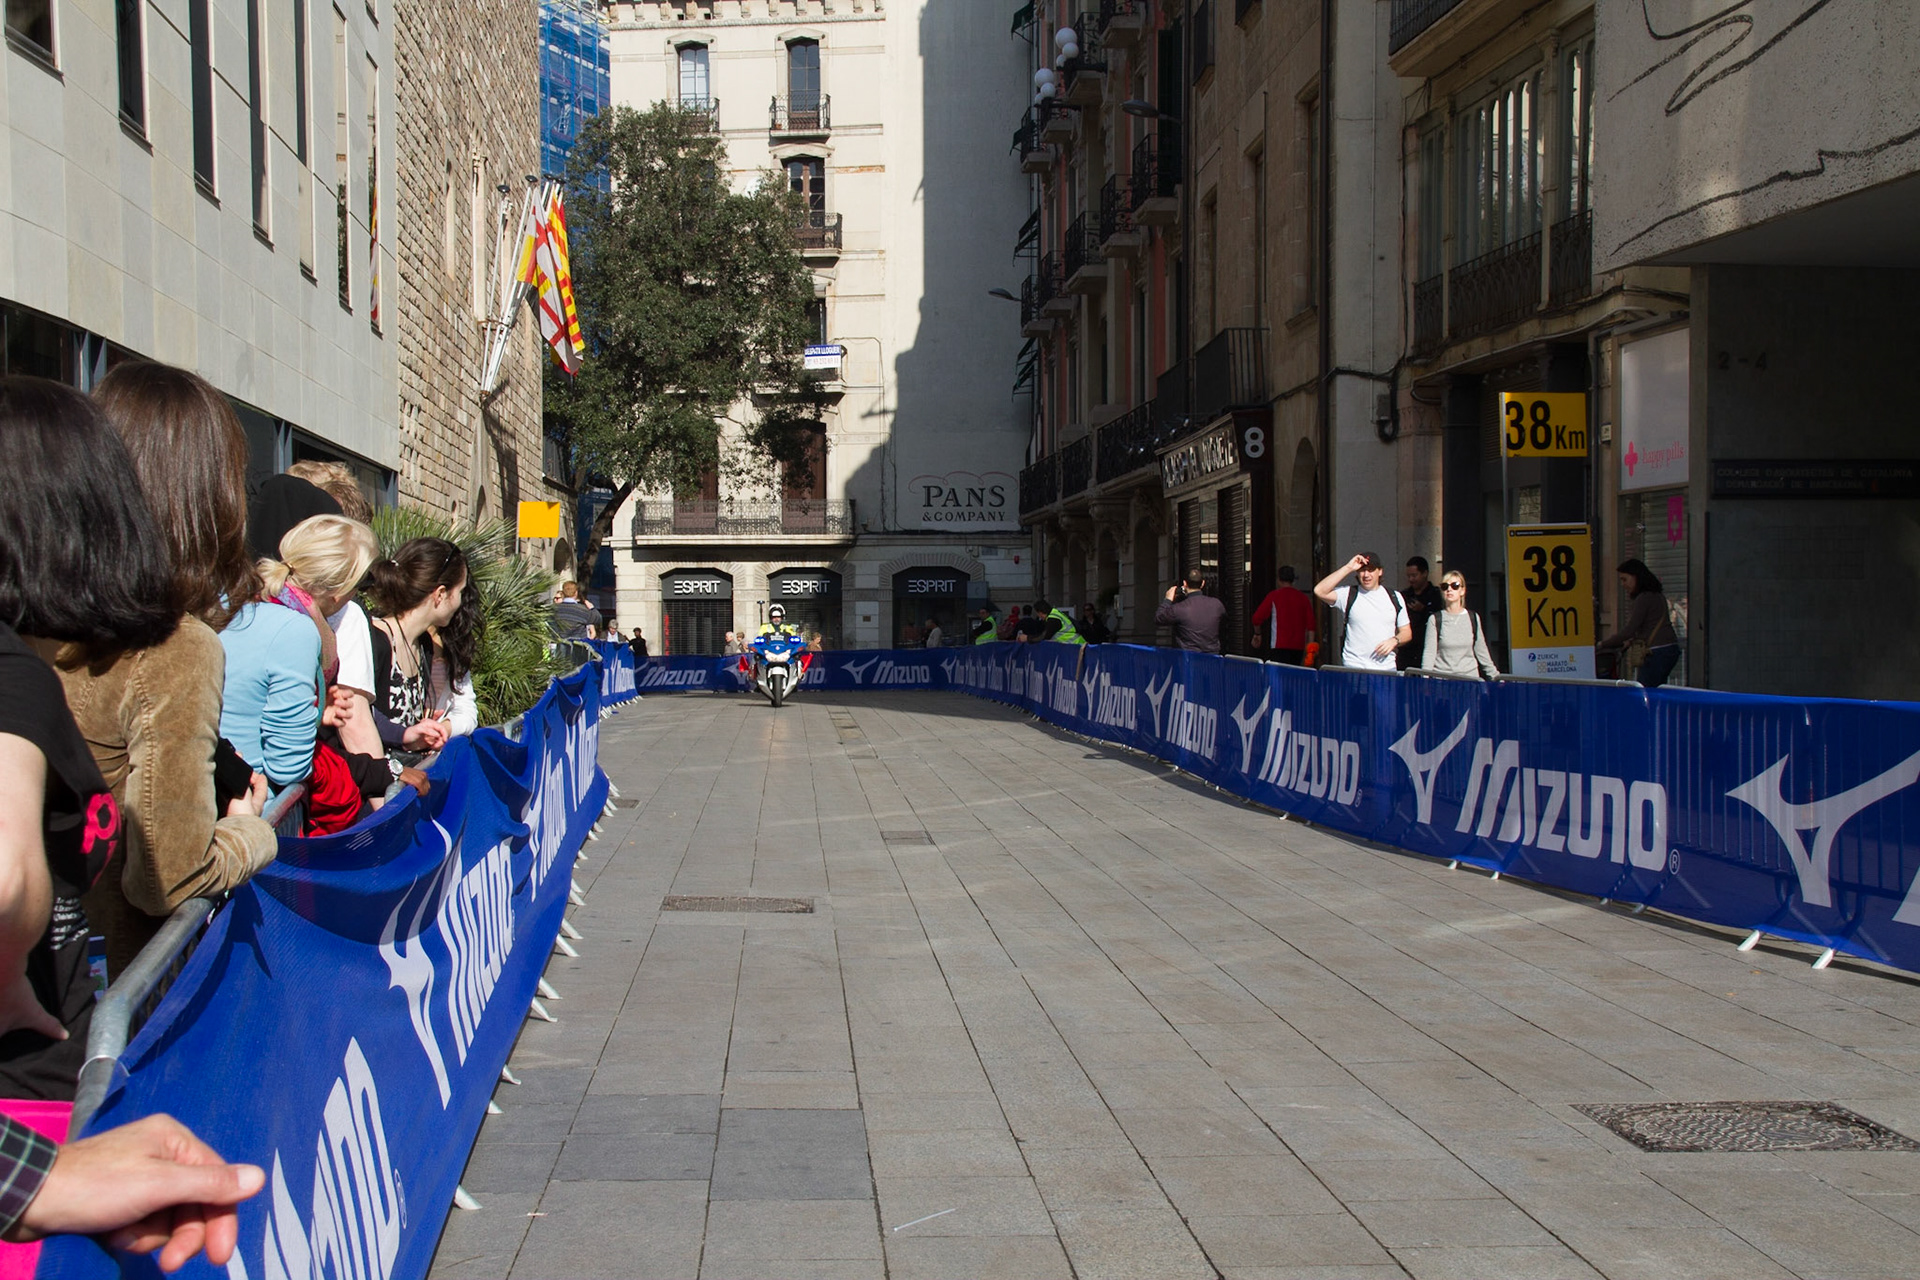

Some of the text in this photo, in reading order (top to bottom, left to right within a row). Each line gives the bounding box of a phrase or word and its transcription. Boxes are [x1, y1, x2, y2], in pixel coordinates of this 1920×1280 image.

[1505, 400, 1585, 450] 38 Km
[1244, 426, 1265, 458] 8
[1642, 441, 1685, 469] happy pills
[922, 485, 1005, 508] PANS
[922, 511, 1005, 522] &COMPANY
[1523, 545, 1576, 592] 38
[674, 580, 720, 594] ESPRIT
[782, 580, 830, 594] ESPRIT
[908, 579, 956, 594] ESPRIT
[1527, 597, 1578, 637] Km
[872, 661, 930, 684] MIZUNO
[1166, 682, 1217, 760] MIZUNO
[1258, 708, 1360, 806] MIZUNO
[1454, 738, 1668, 873] MIZUNO
